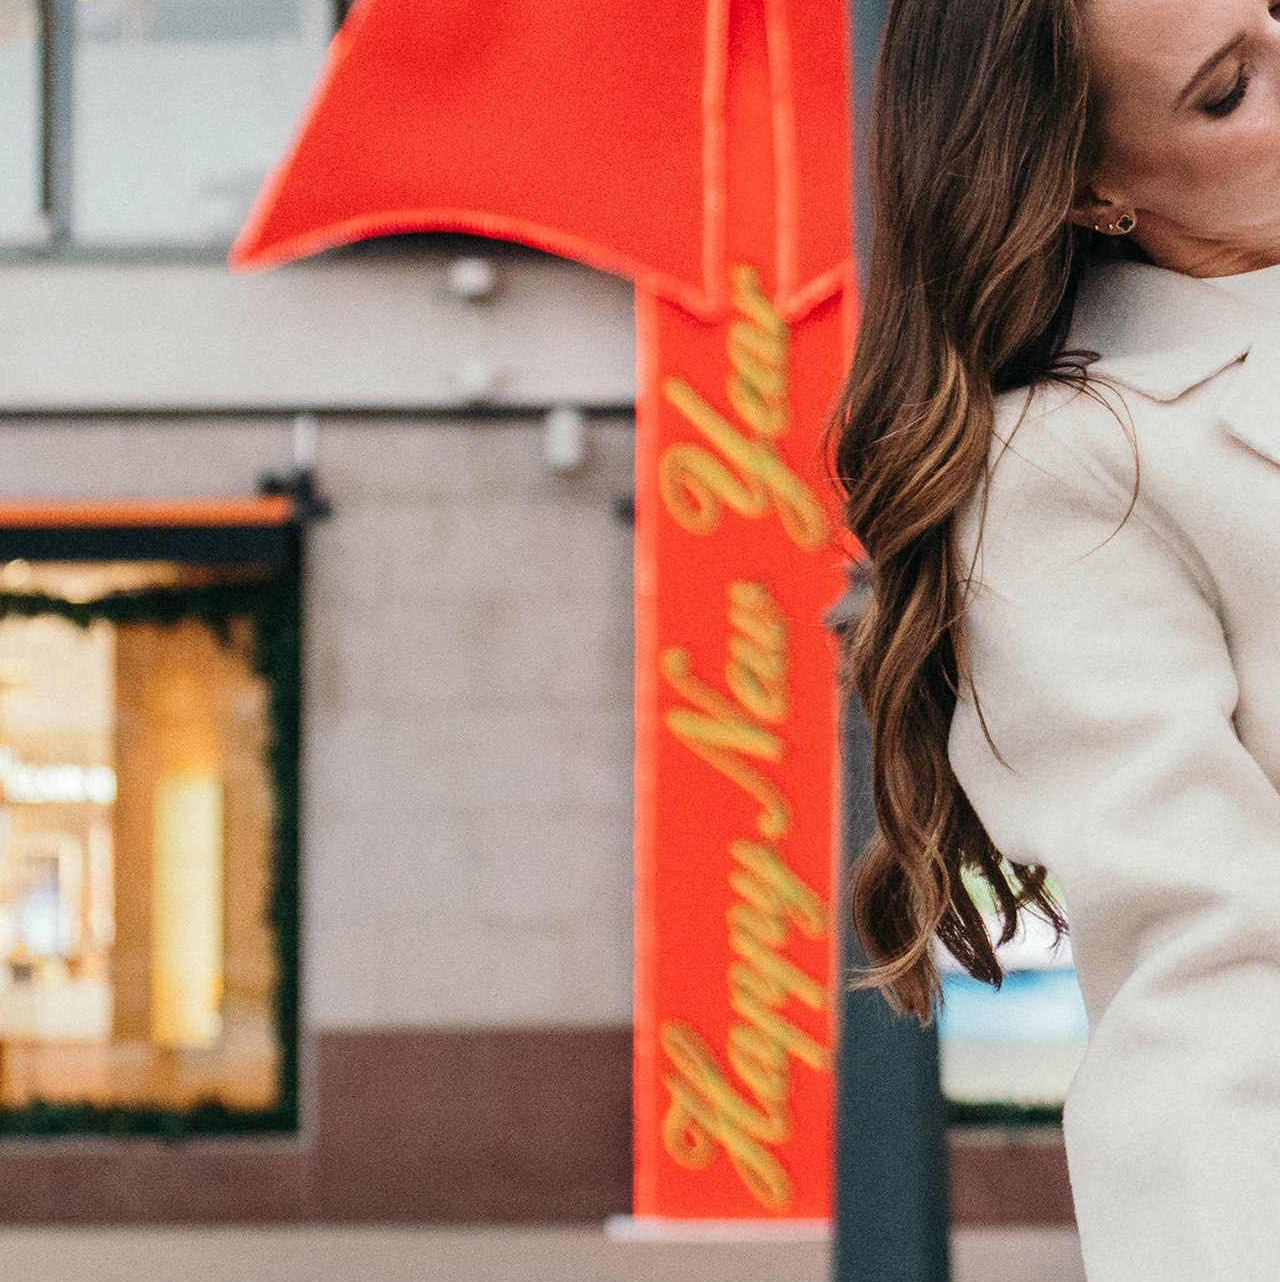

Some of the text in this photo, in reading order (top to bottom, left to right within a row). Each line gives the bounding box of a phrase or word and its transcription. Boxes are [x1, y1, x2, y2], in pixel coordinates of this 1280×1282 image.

[657, 264, 829, 1209] Happy New Year
